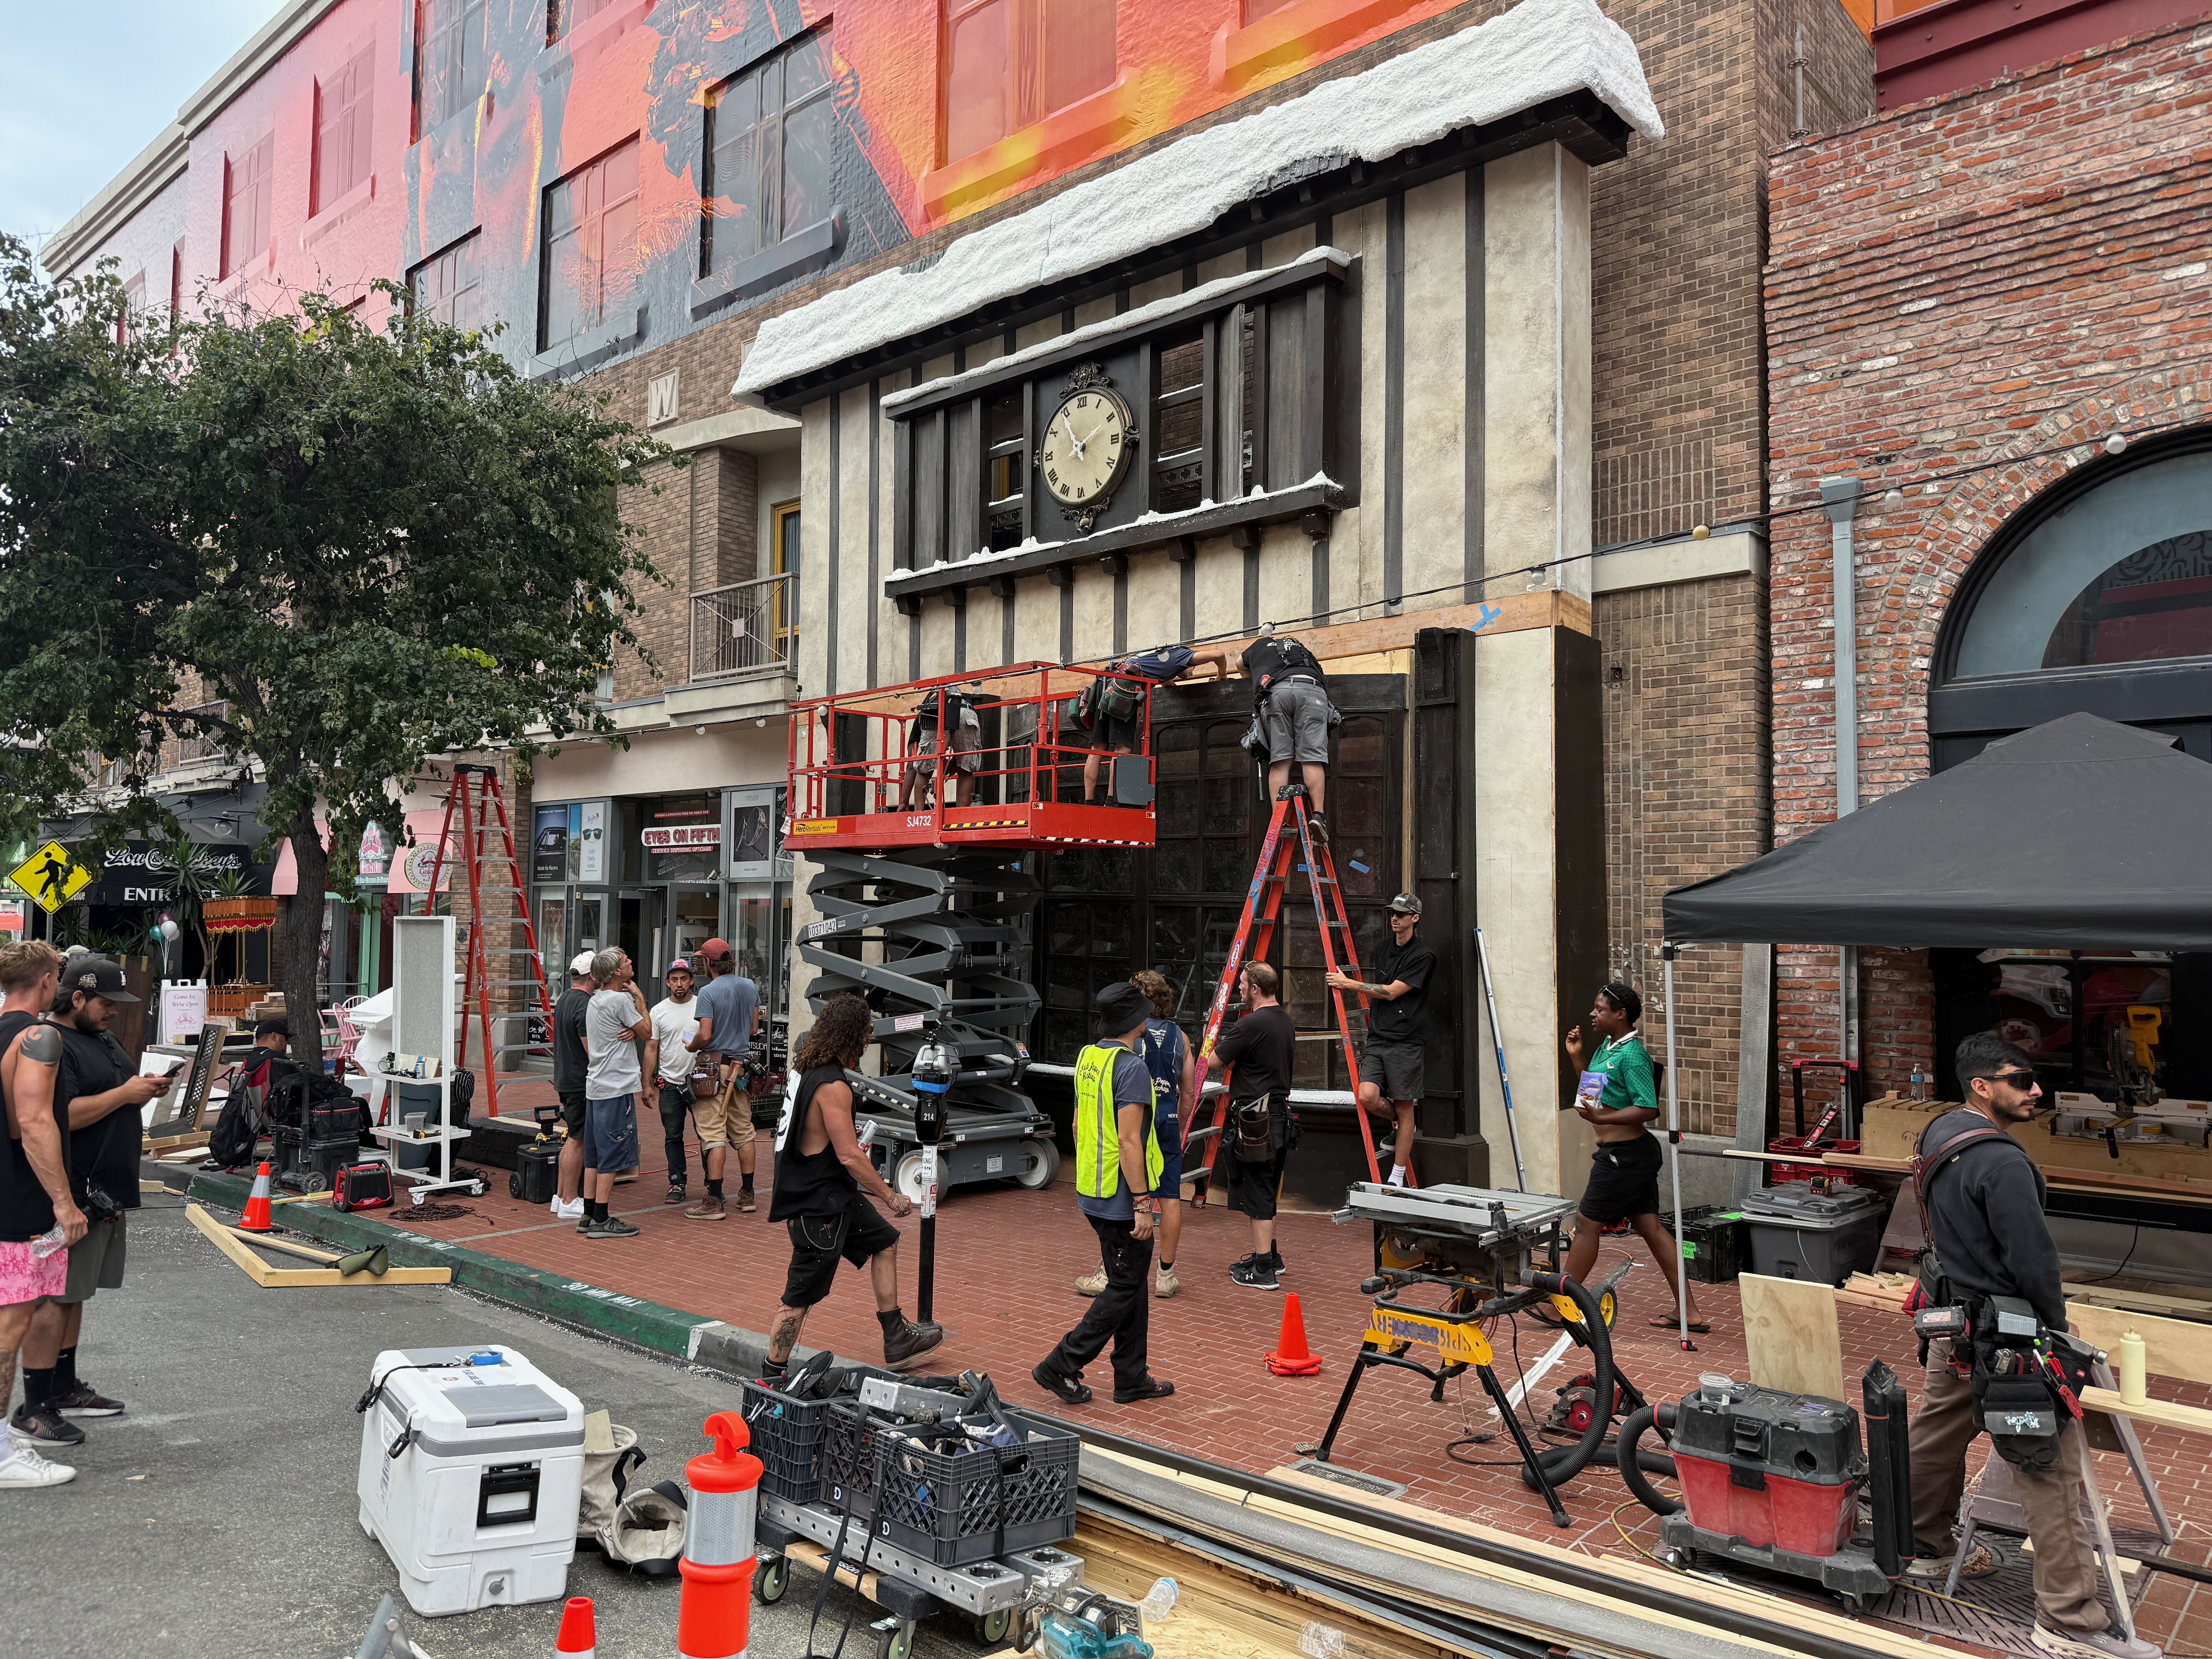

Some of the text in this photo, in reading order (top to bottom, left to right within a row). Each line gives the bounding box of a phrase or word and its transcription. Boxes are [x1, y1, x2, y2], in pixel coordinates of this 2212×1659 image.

[907, 815, 931, 828] SJ4732
[644, 827, 720, 845] EYES ON FIFTH
[809, 921, 836, 937] 10371042
[924, 1113, 934, 1121] 214
[581, 1288, 617, 1298] MIN
[607, 1295, 647, 1307] MAX
